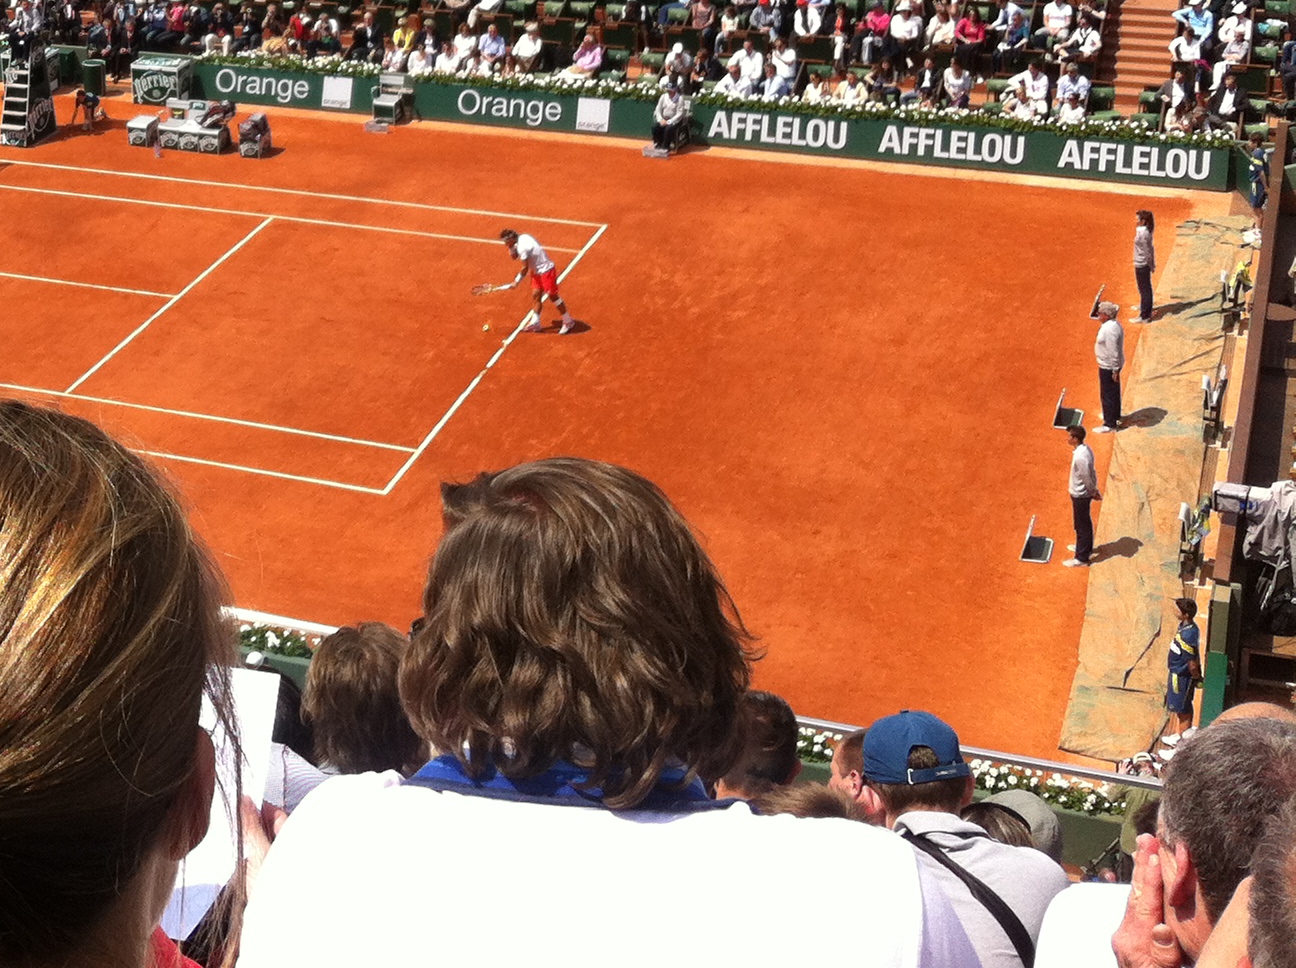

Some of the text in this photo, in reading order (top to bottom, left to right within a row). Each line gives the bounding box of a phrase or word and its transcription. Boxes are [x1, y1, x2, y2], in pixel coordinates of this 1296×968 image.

[215, 68, 309, 103] Orange
[457, 89, 562, 126] Orange
[707, 110, 847, 150] AFFLELOU
[878, 125, 1025, 165] AFFLELOU
[1057, 139, 1211, 180] AFFLELOU
